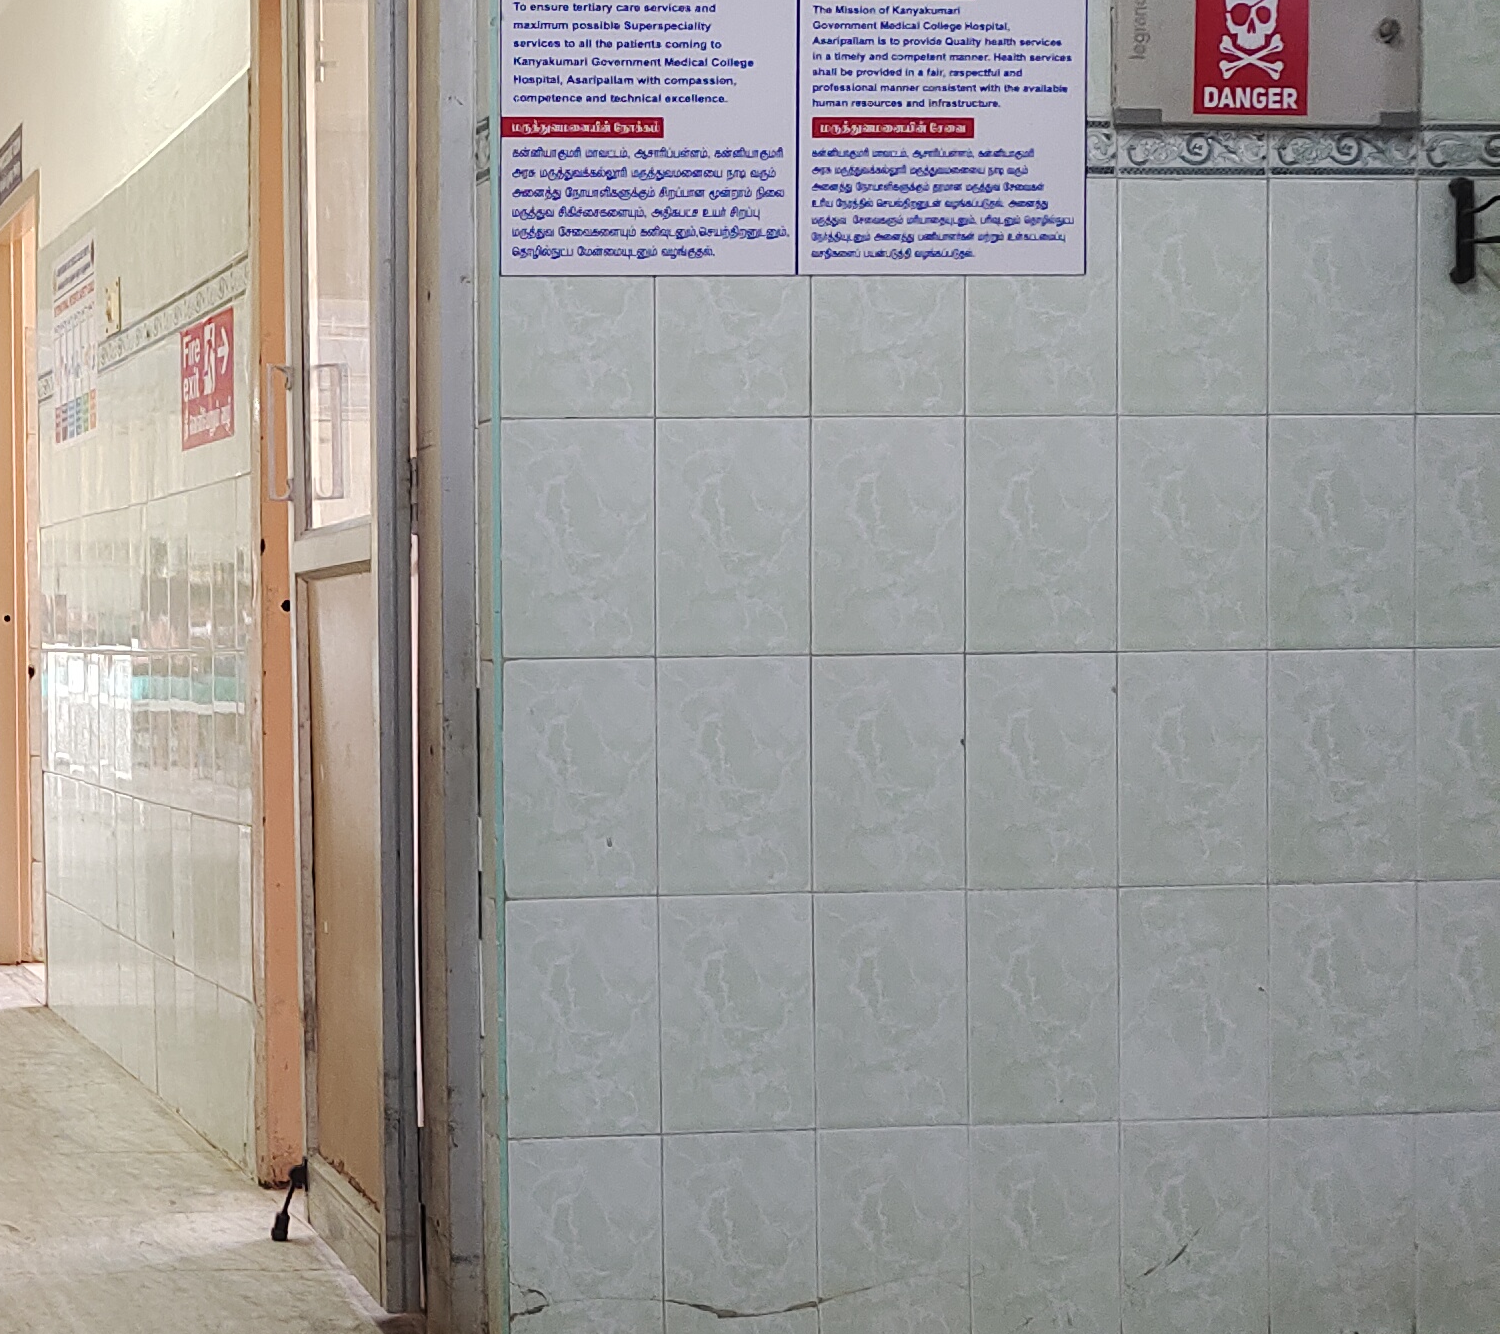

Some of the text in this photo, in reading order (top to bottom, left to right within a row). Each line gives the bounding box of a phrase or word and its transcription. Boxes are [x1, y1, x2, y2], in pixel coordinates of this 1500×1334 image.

[513, 2, 526, 11] To
[573, 2, 612, 14] tertiary
[644, 4, 691, 12] services
[695, 4, 716, 12] and
[813, 6, 960, 17] The Mission of Kanyakumari
[513, 21, 711, 32] maximum possible Superspeciality
[513, 39, 722, 50] services to all the patients coming to
[513, 57, 754, 69] Kanyakumari Government Medical College
[567, 76, 633, 86] Asaripallam
[637, 76, 660, 85] with
[513, 94, 582, 105] competence
[586, 94, 606, 103] and
[610, 94, 661, 103] technical
[1204, 87, 1297, 109] DANGER
[183, 335, 200, 368] Fire
[184, 367, 200, 402] exit
